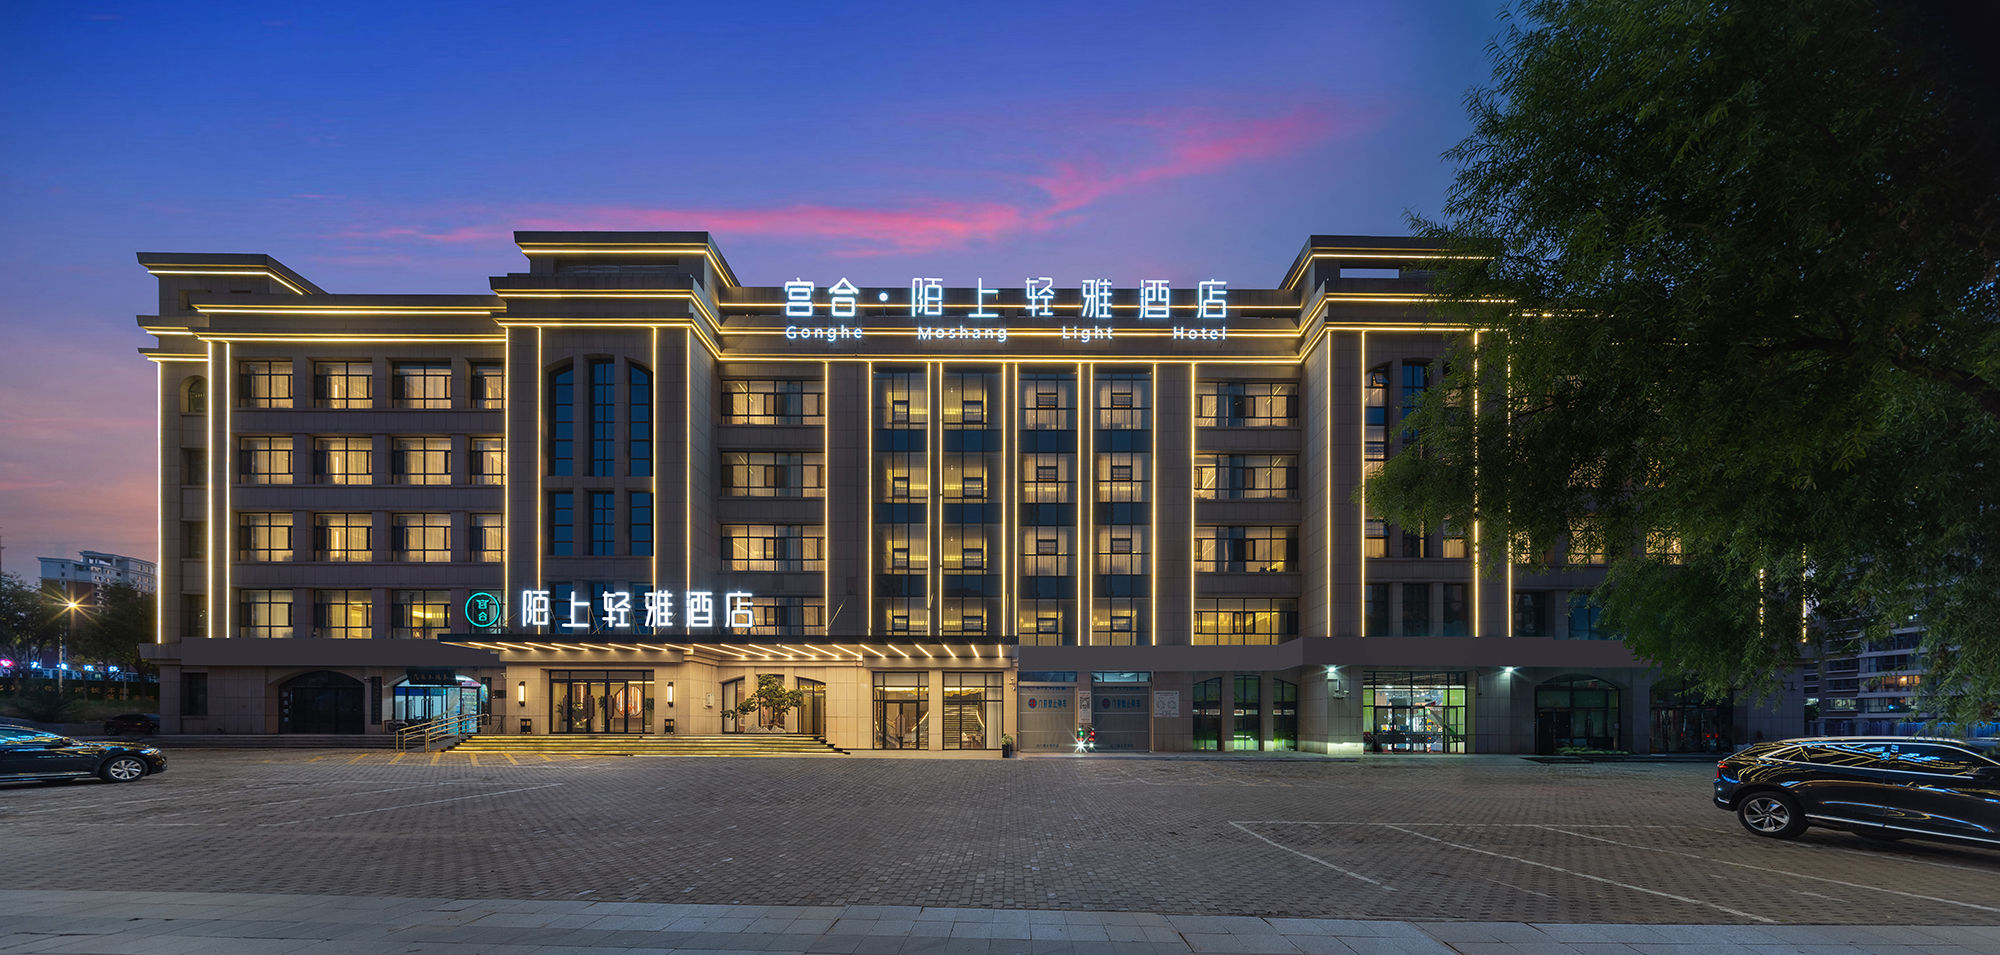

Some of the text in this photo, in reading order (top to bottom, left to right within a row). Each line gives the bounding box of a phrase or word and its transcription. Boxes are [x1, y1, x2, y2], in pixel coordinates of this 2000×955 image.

[785, 277, 1228, 319] 宫合·陌上轻雅酒店
[786, 325, 1227, 343] Gonghe Moshang Light Hotel
[522, 590, 754, 627] 陌上轻雅酒店
